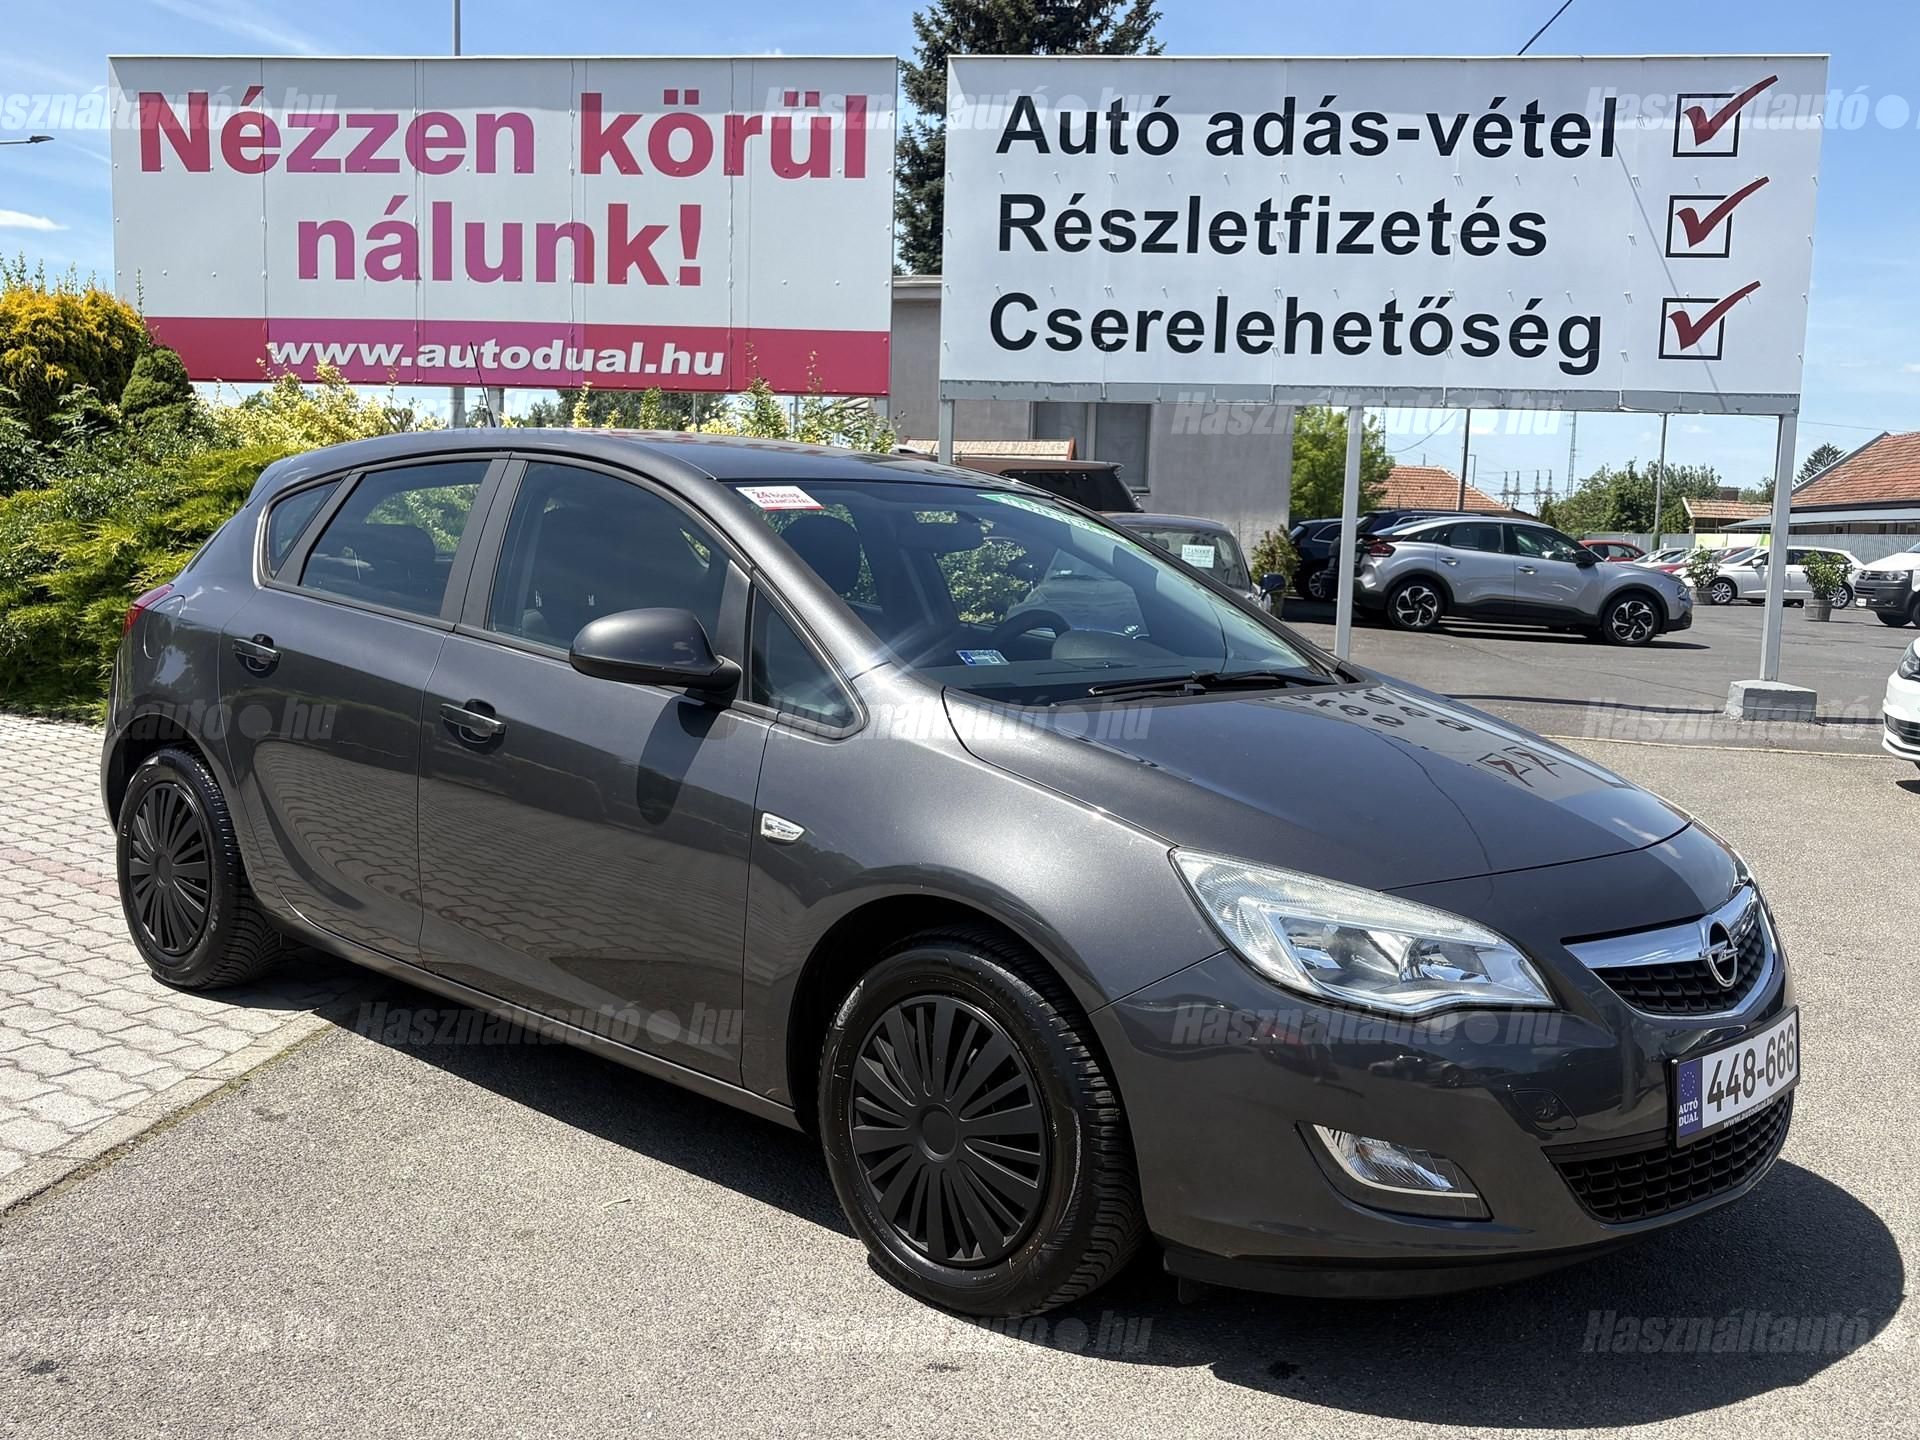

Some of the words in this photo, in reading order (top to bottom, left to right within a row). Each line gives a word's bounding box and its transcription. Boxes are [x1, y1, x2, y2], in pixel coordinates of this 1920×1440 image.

[139, 85, 535, 176] Nézzen
[580, 89, 868, 180] körül
[996, 95, 1180, 156] Autó
[1205, 94, 1617, 158] adás-vétel
[298, 195, 703, 287] nálunk!
[997, 193, 1548, 256] Részletfizetés
[267, 338, 725, 377] www.autodual.hu
[990, 291, 1602, 376] Cserelehetőség
[1707, 1022, 1795, 1113] 448-666
[1678, 1097, 1699, 1115] AUTÓ
[1678, 1111, 1699, 1127] DUAL
